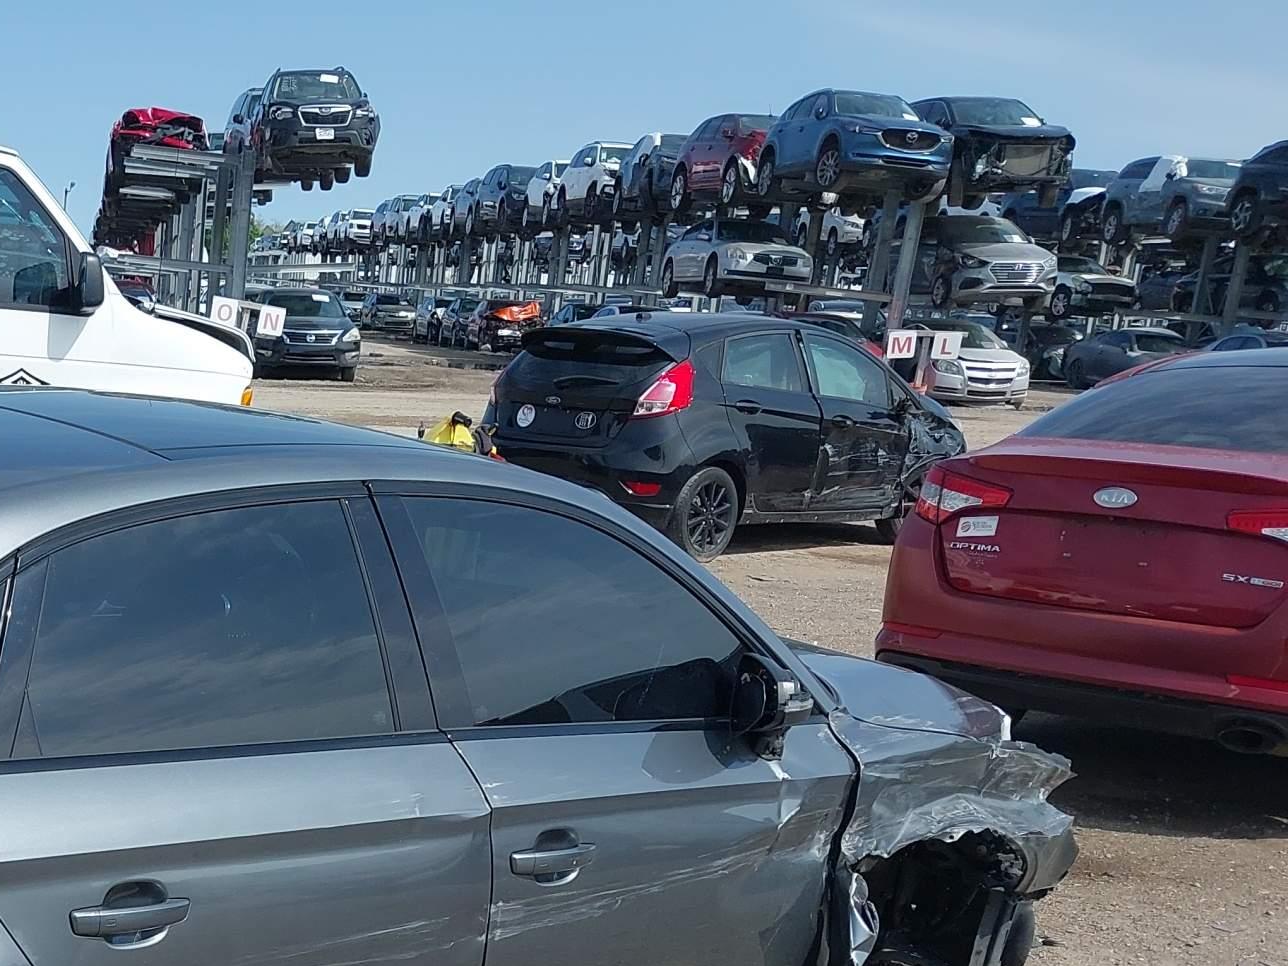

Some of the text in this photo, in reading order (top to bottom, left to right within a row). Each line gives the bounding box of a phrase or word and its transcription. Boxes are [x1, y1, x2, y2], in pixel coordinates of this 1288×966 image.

[217, 303, 232, 321] O
[263, 312, 280, 331] N
[891, 336, 912, 354] M
[940, 338, 952, 355] L
[950, 541, 1001, 553] OPTIMA
[1223, 573, 1249, 583] SX
